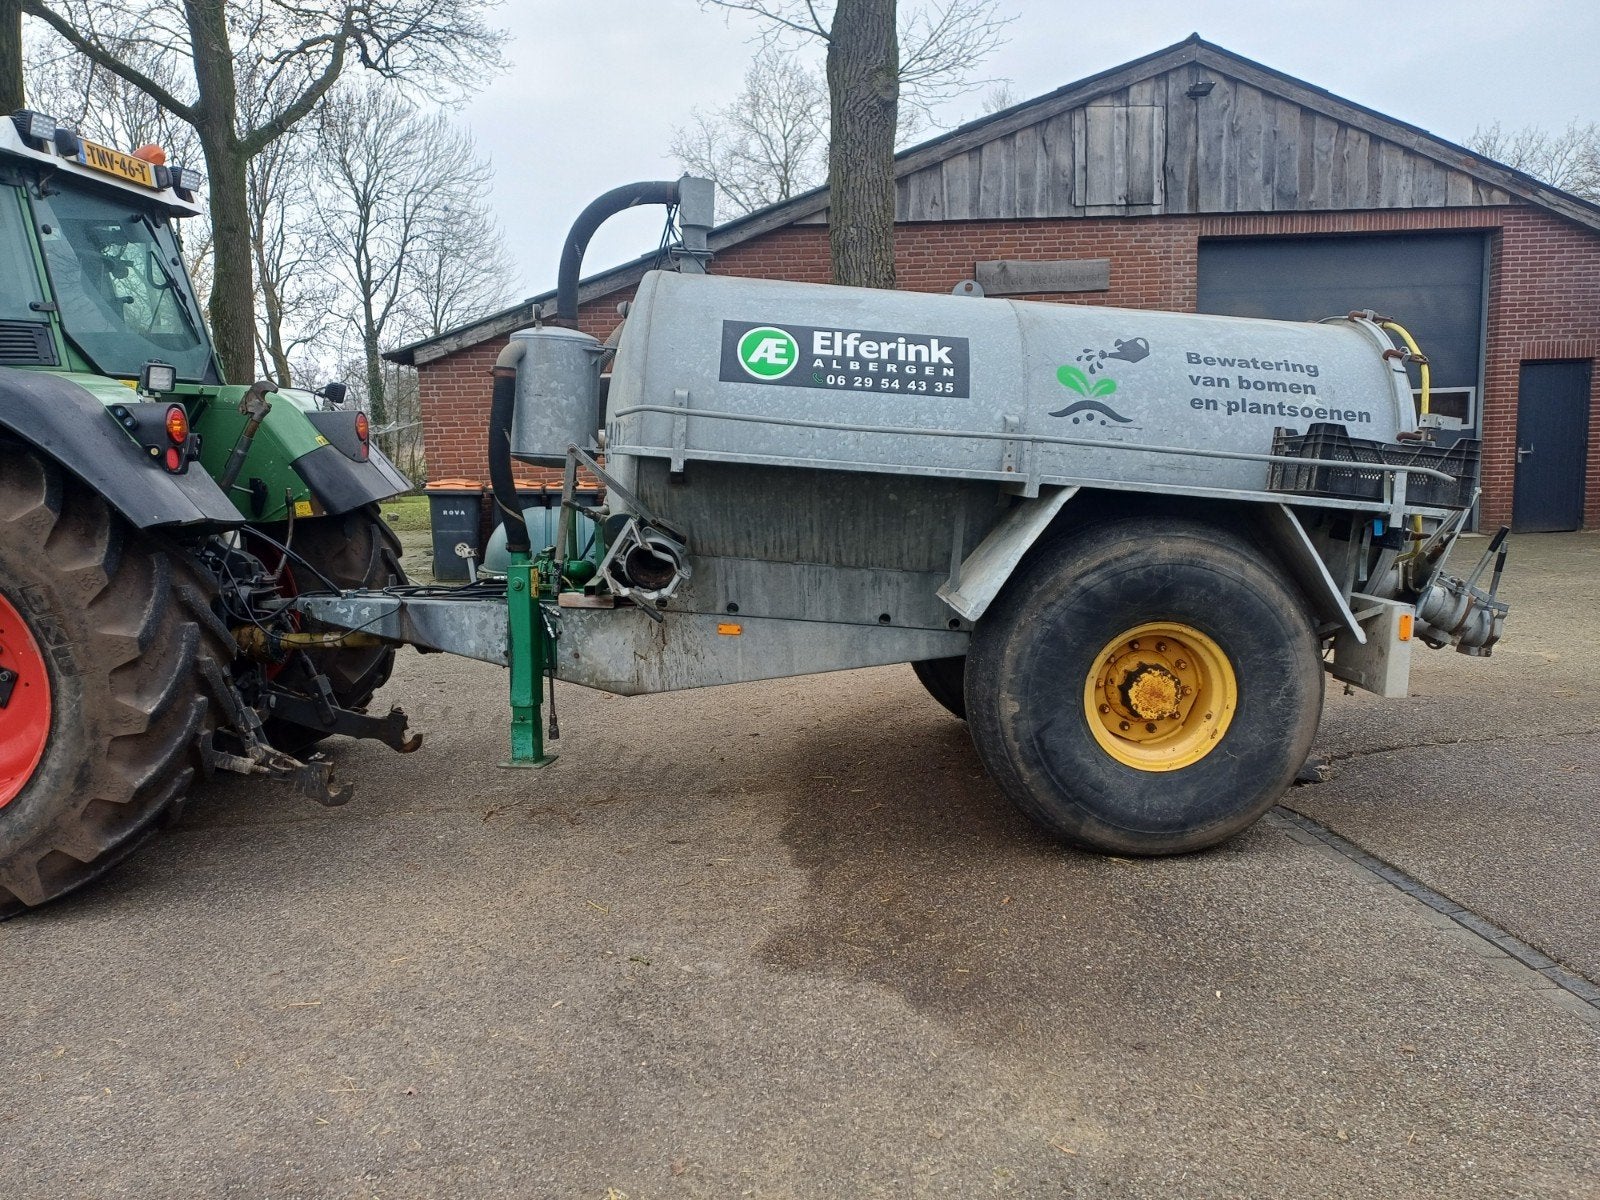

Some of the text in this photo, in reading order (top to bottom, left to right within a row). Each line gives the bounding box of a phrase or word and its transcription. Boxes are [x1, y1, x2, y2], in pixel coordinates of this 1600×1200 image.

[813, 330, 954, 364] Elferink
[813, 358, 955, 377] ALBERGEN
[1186, 352, 1320, 378] Bewatering
[826, 374, 955, 393] 06 29 54 43 35
[1188, 374, 1317, 396] van bomen
[1190, 397, 1372, 424] en plantsoenen
